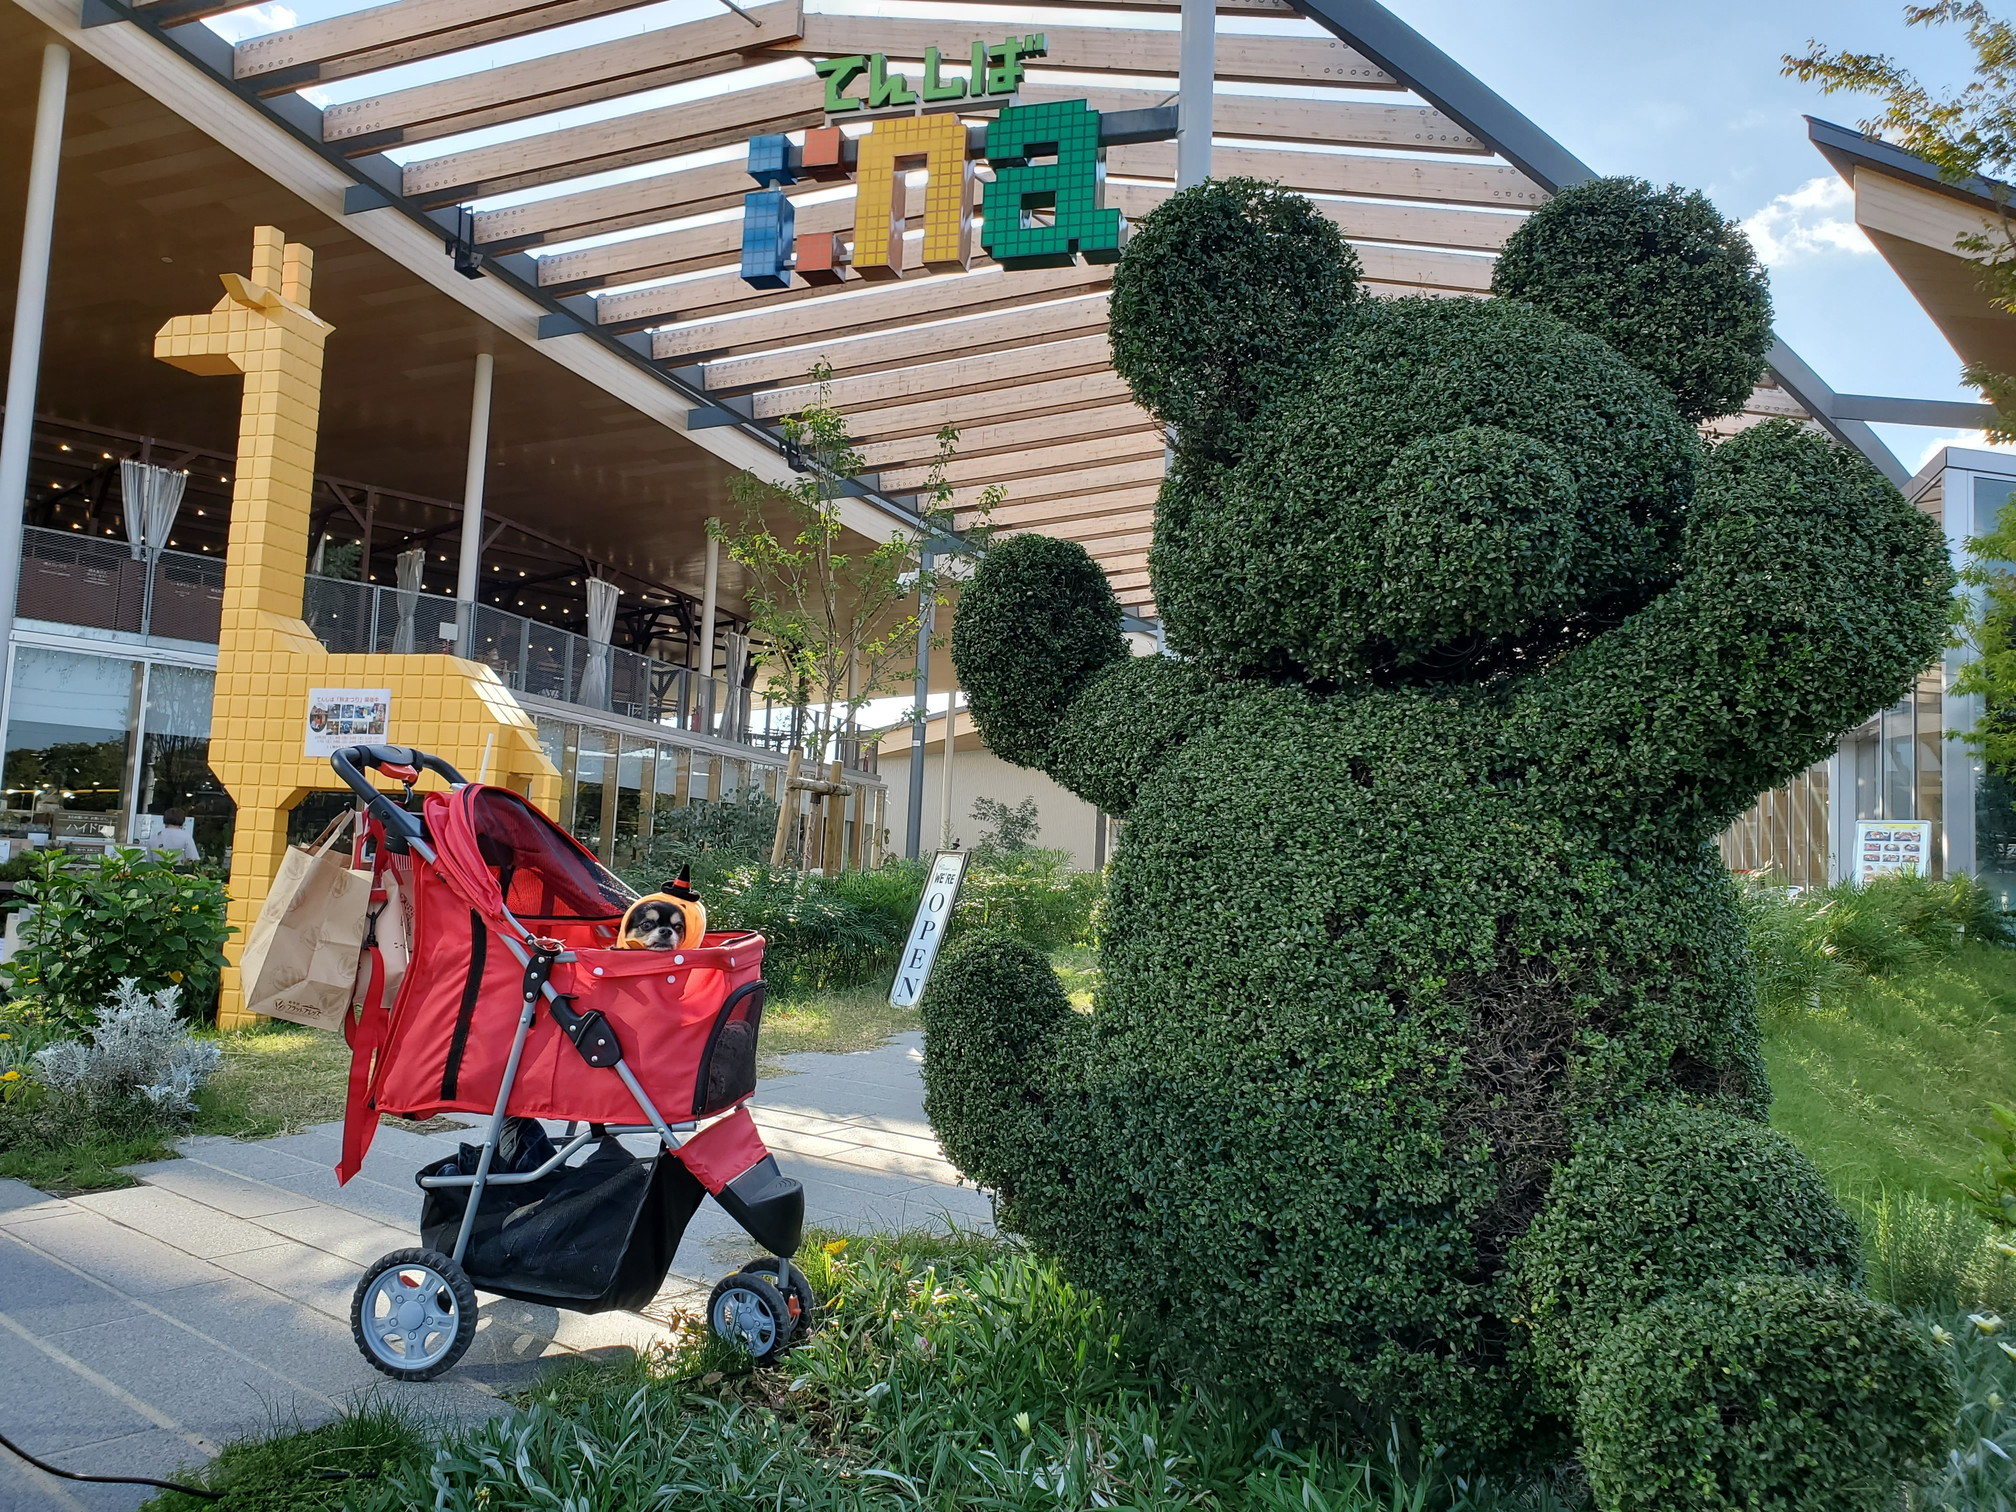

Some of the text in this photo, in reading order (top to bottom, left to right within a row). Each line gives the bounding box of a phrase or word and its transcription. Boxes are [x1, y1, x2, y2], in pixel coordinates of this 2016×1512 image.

[815, 33, 1048, 112] てんしば
[935, 873, 956, 884] WE'RE
[897, 892, 945, 999] OPEN
